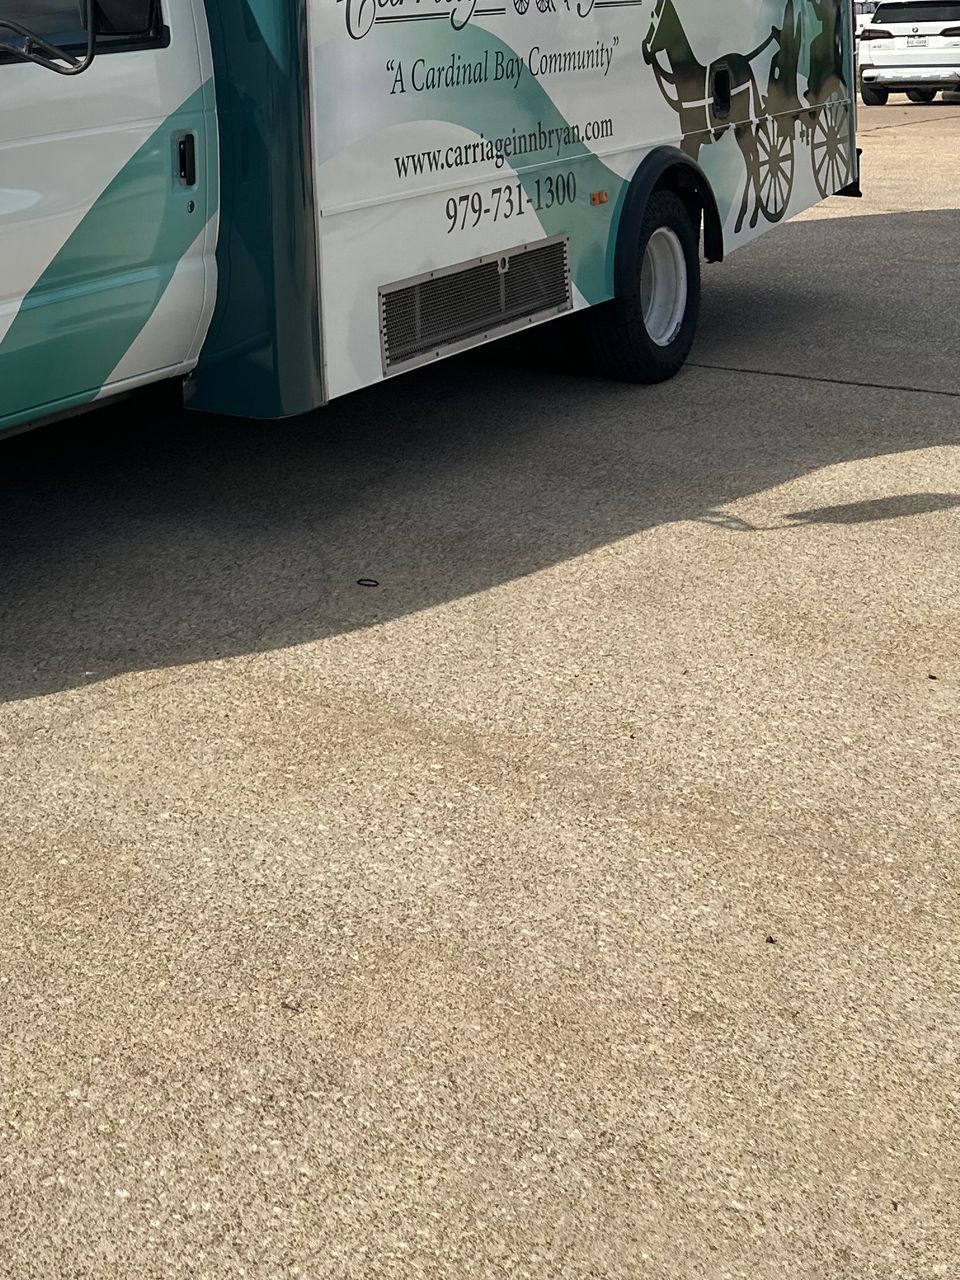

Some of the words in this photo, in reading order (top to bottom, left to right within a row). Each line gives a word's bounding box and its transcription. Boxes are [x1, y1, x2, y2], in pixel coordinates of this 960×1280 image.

[411, 50, 489, 92] Cardinal
[493, 50, 524, 89] Bay
[394, 117, 614, 179] www.carriageinnbryan.com
[445, 171, 577, 235] 979-731-1300
